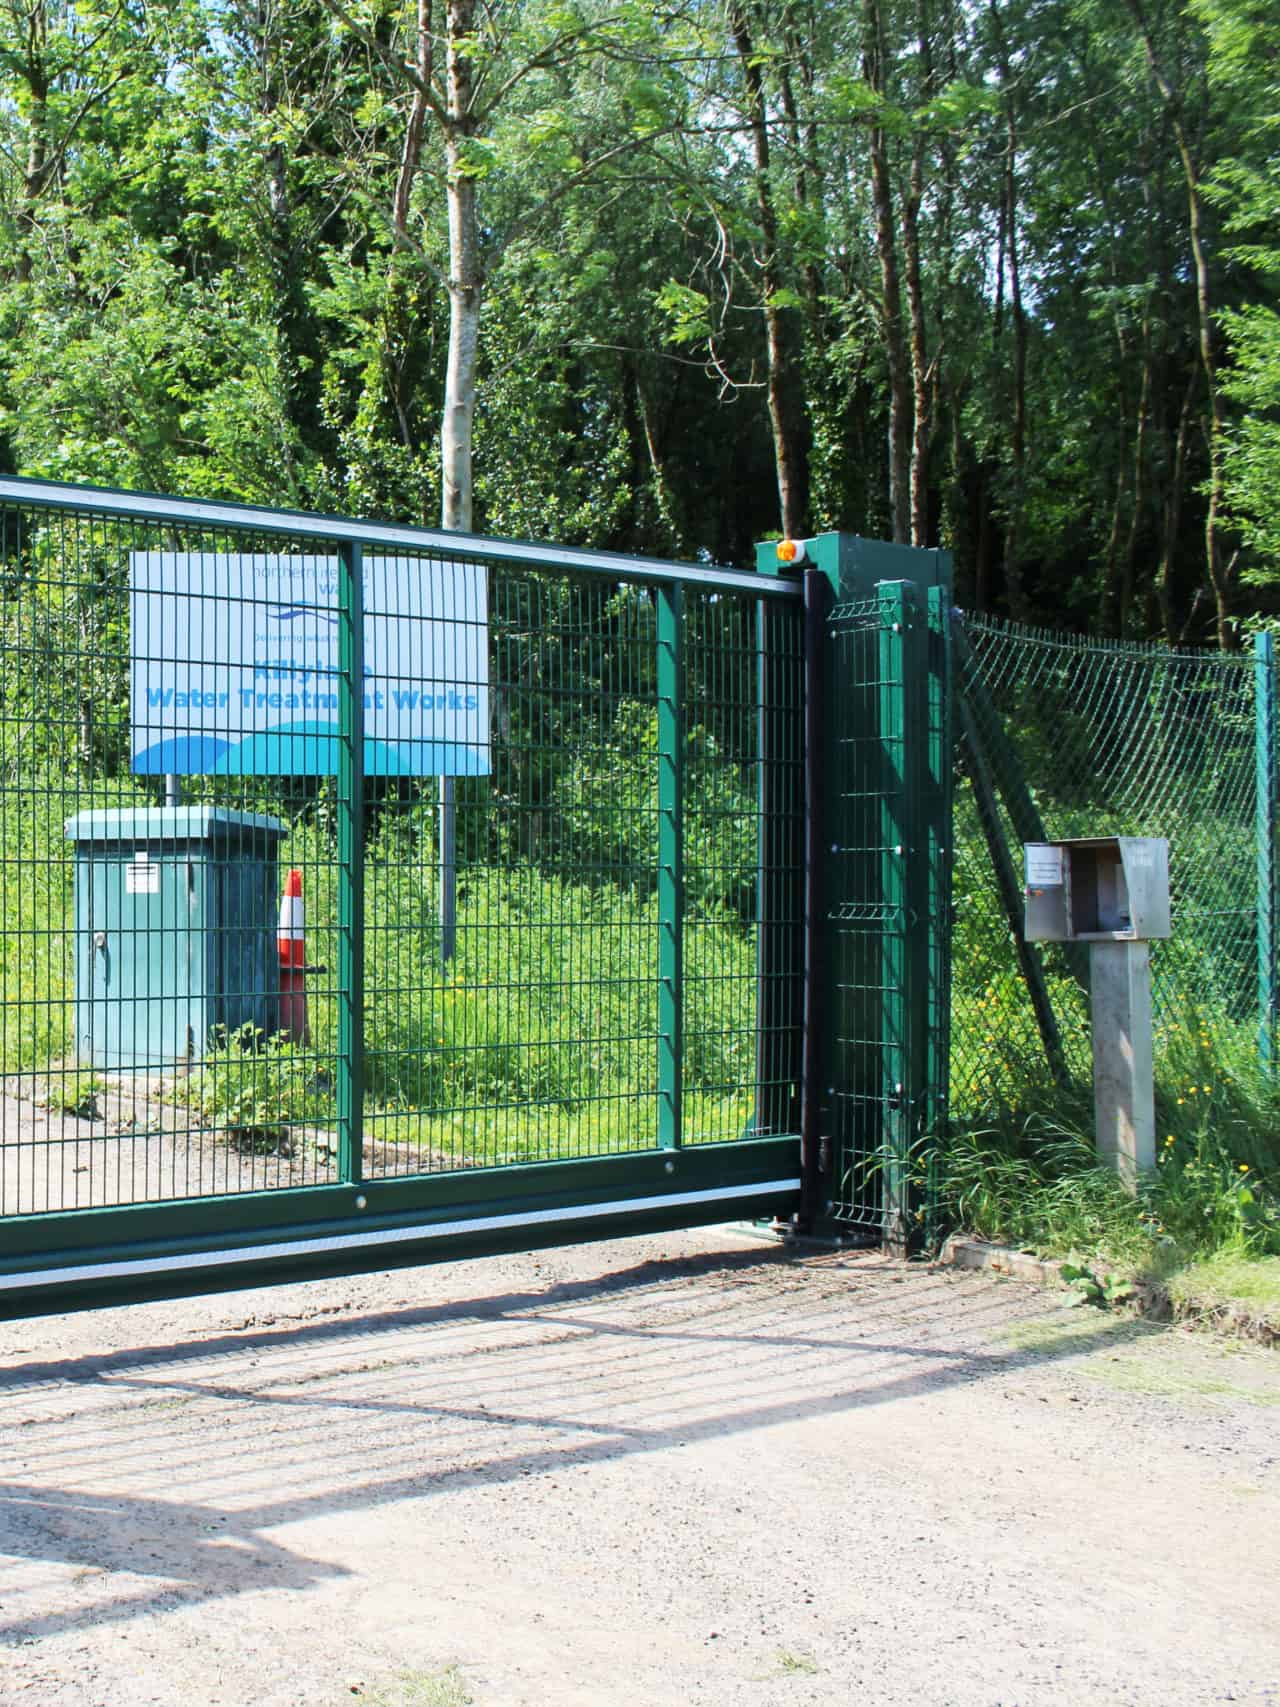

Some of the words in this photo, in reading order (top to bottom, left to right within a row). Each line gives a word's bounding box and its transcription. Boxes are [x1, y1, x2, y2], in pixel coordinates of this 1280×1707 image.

[145, 687, 229, 709] Water
[237, 688, 384, 710] Treatmnt
[391, 689, 478, 711] Works
